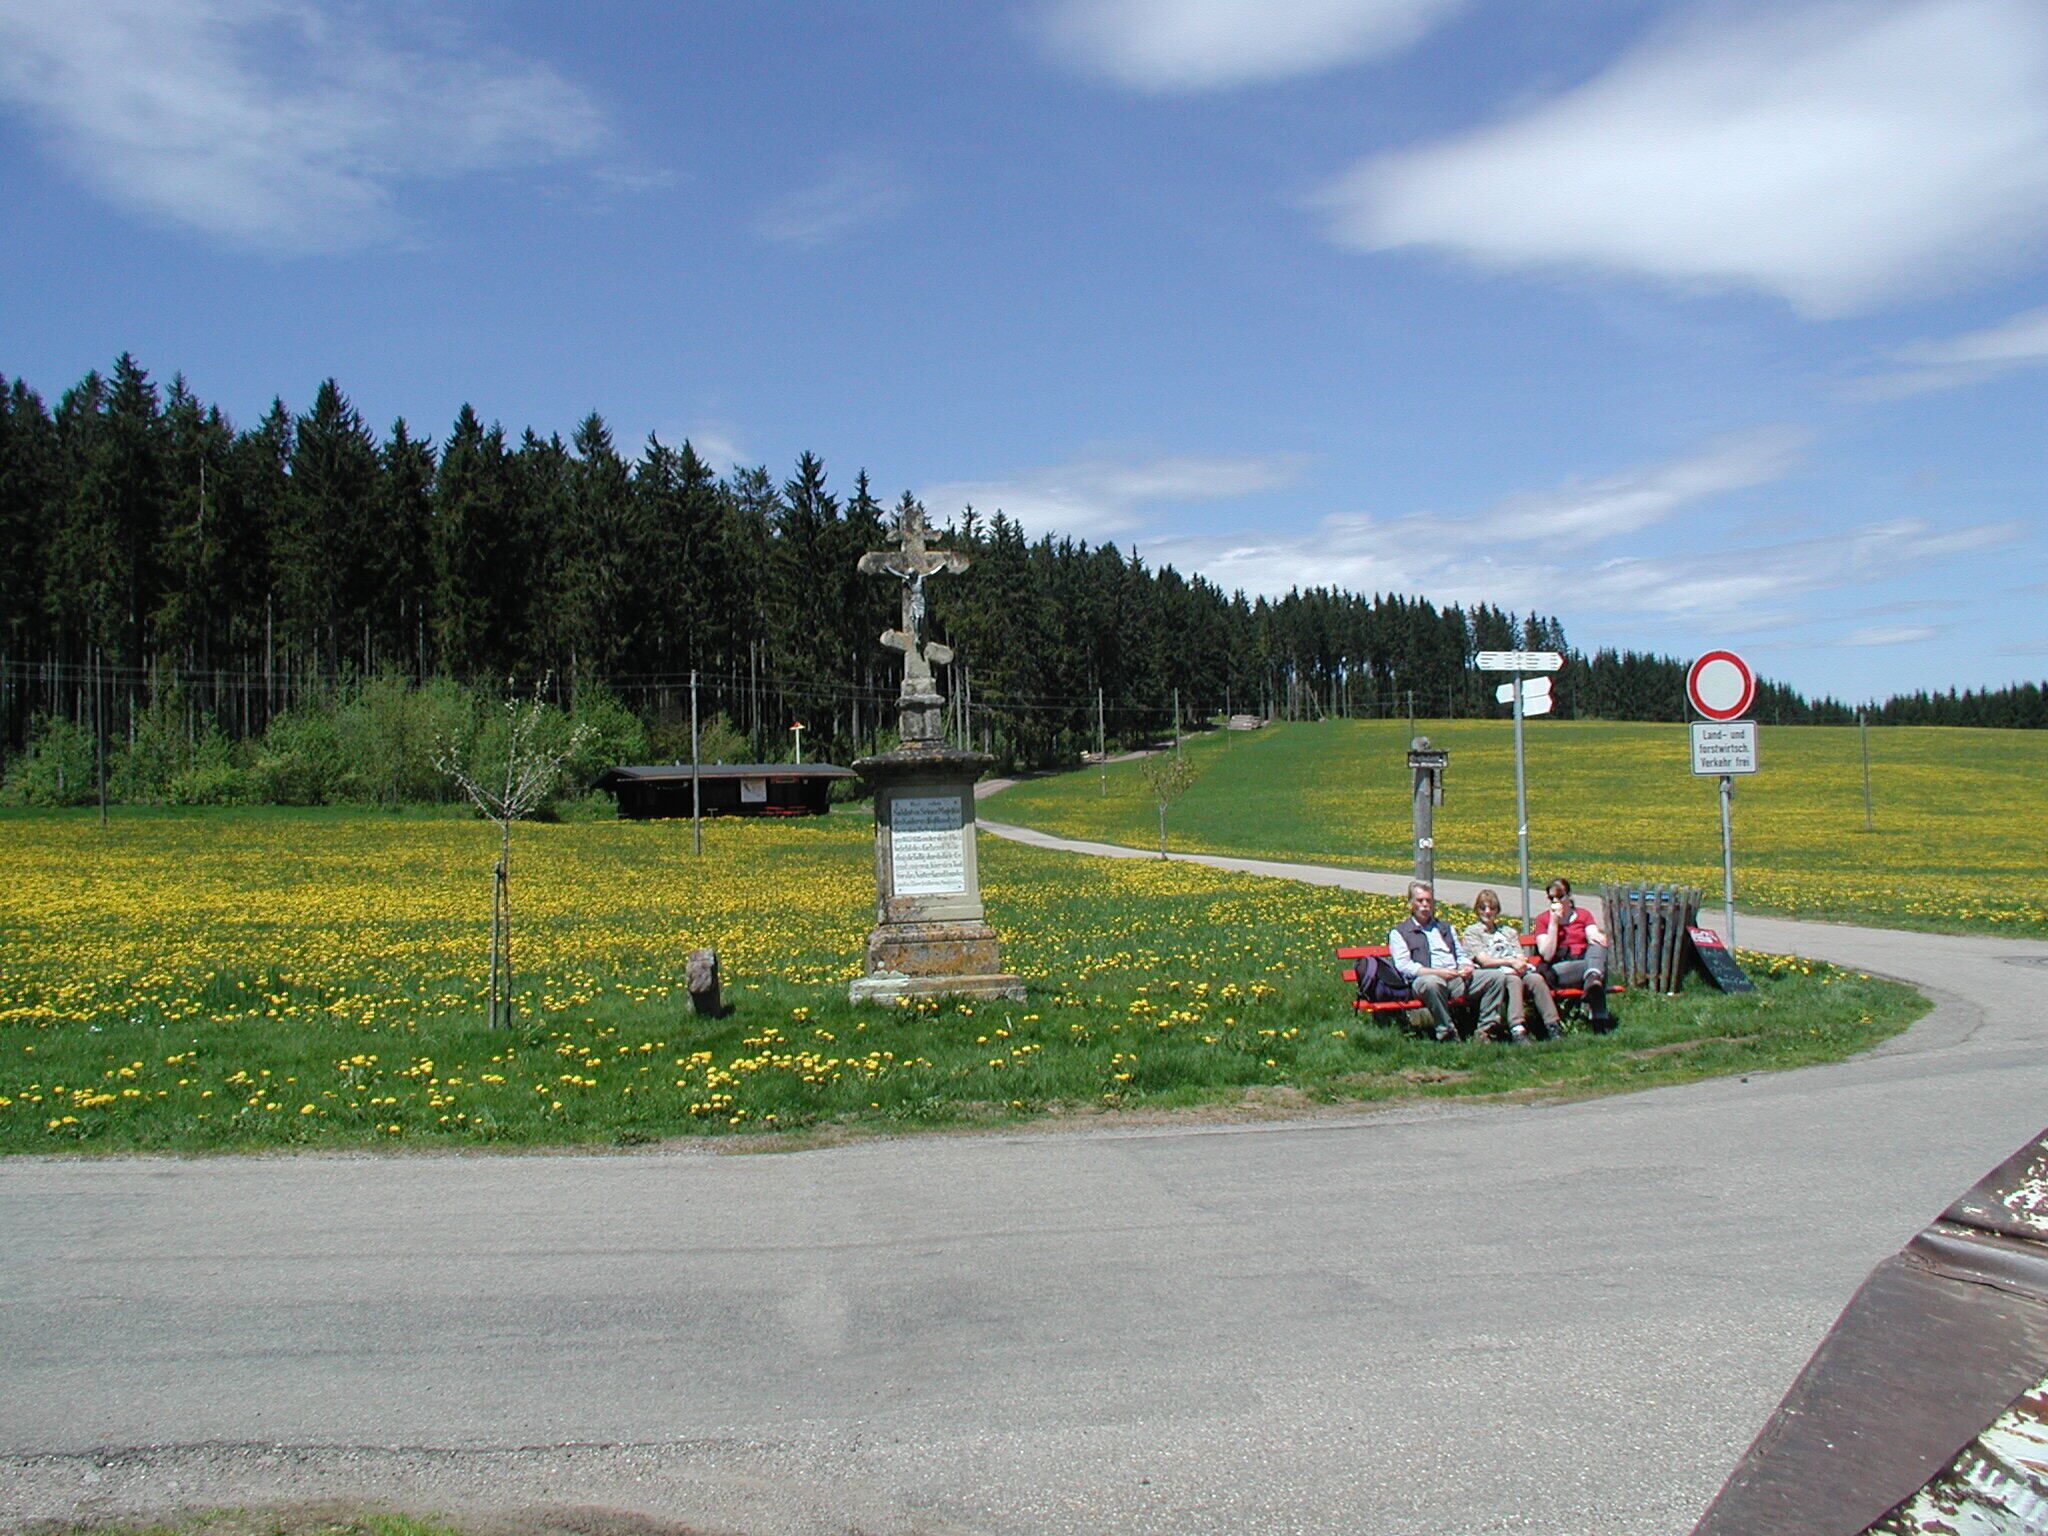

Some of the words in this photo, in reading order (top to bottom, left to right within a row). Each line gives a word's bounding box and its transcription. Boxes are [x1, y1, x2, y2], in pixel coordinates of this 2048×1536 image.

[1702, 729, 1728, 740] Land-
[1730, 729, 1745, 740] und
[1700, 757, 1731, 768] Verkehr
[1735, 756, 1750, 767] frei
